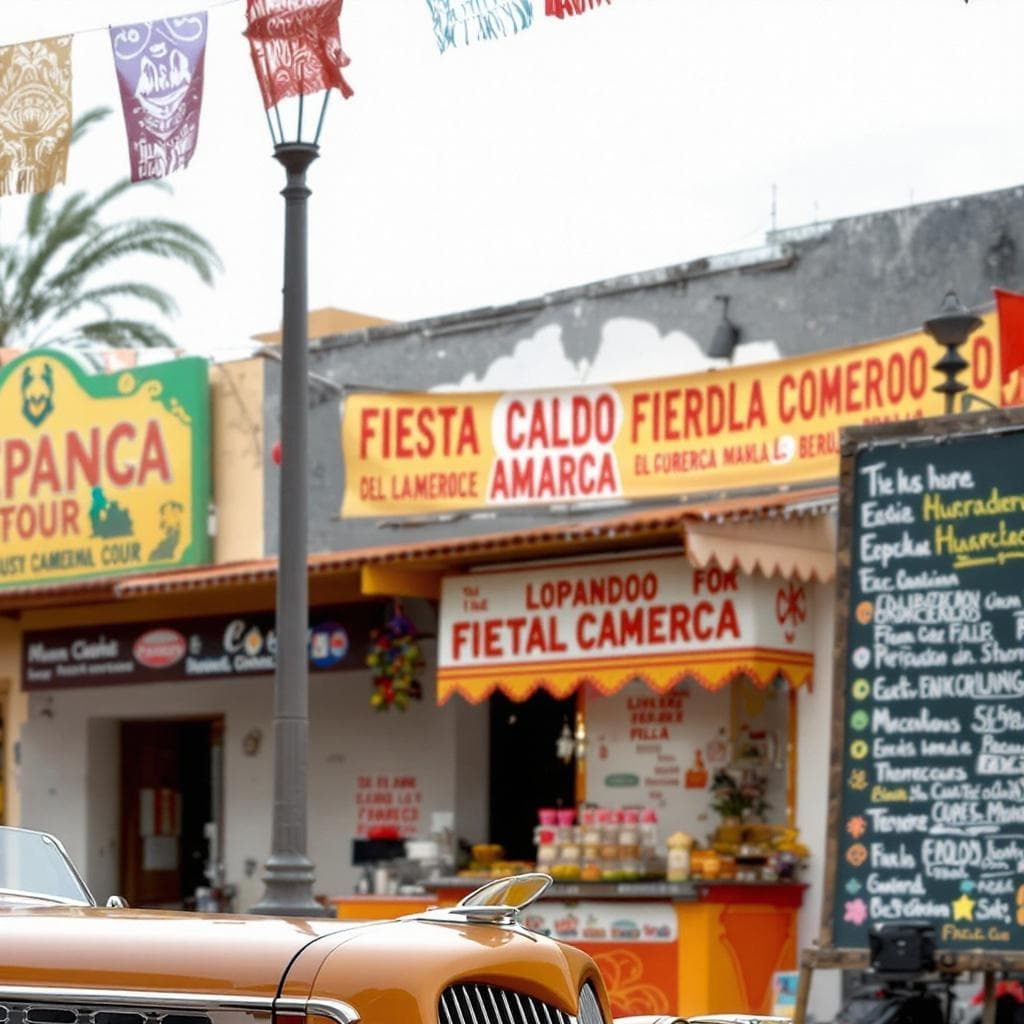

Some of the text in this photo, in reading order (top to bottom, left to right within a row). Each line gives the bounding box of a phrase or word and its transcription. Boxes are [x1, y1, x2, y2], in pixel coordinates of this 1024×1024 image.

[359, 405, 480, 460] FIESTA
[506, 393, 616, 450] CALDO
[631, 379, 767, 444] FIERDLA
[778, 346, 928, 424] COMEROO
[490, 453, 617, 499] AMARCA
[0, 499, 80, 543] TOUR
[526, 572, 658, 611] LOPANDOO
[452, 616, 568, 660] FIETAL
[576, 598, 741, 650] CAMERCA
